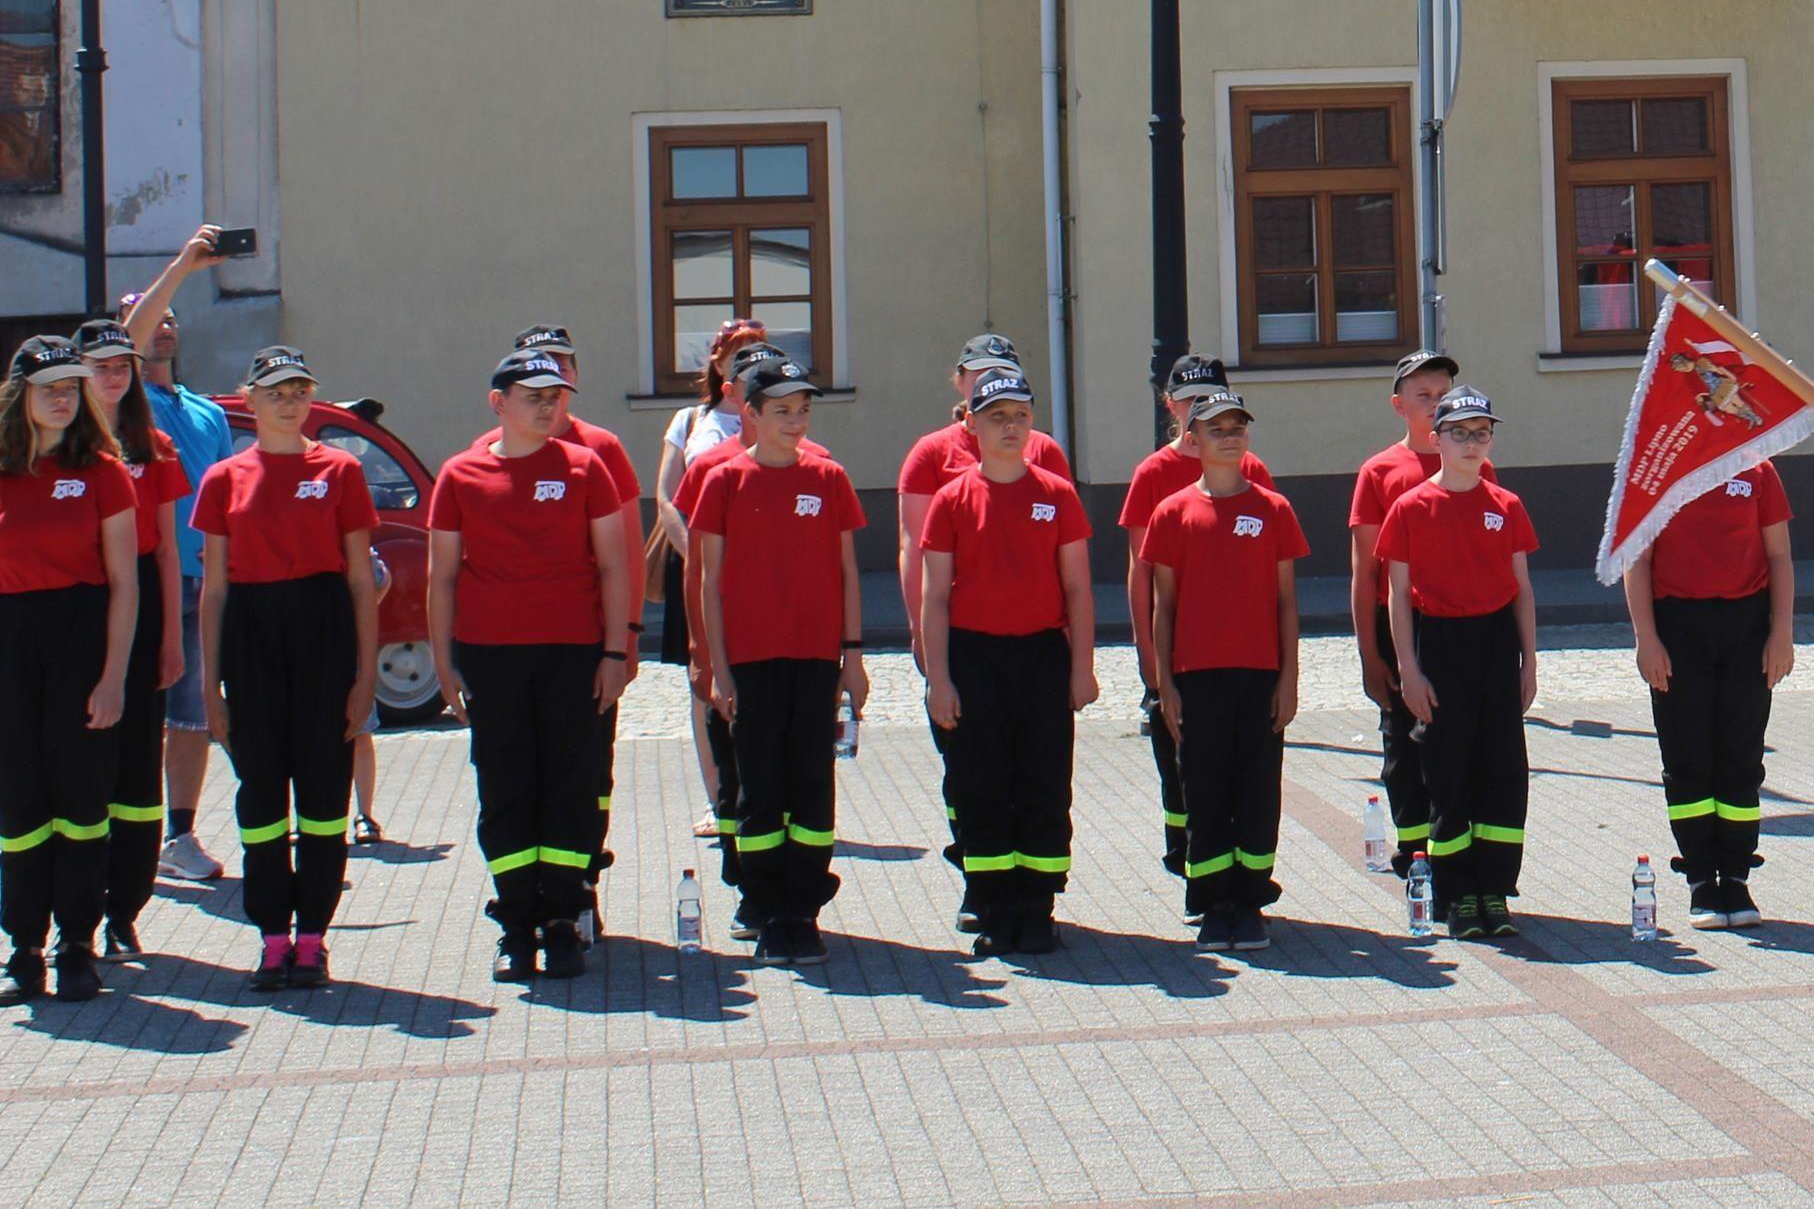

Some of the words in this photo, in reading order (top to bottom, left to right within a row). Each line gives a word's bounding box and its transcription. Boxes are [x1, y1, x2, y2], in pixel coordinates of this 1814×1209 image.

[1630, 456, 1649, 484] MDP
[1644, 424, 1668, 456] Lipno
[1648, 481, 1661, 496] 04
[1657, 452, 1678, 479] maja
[1672, 425, 1699, 452] 2019
